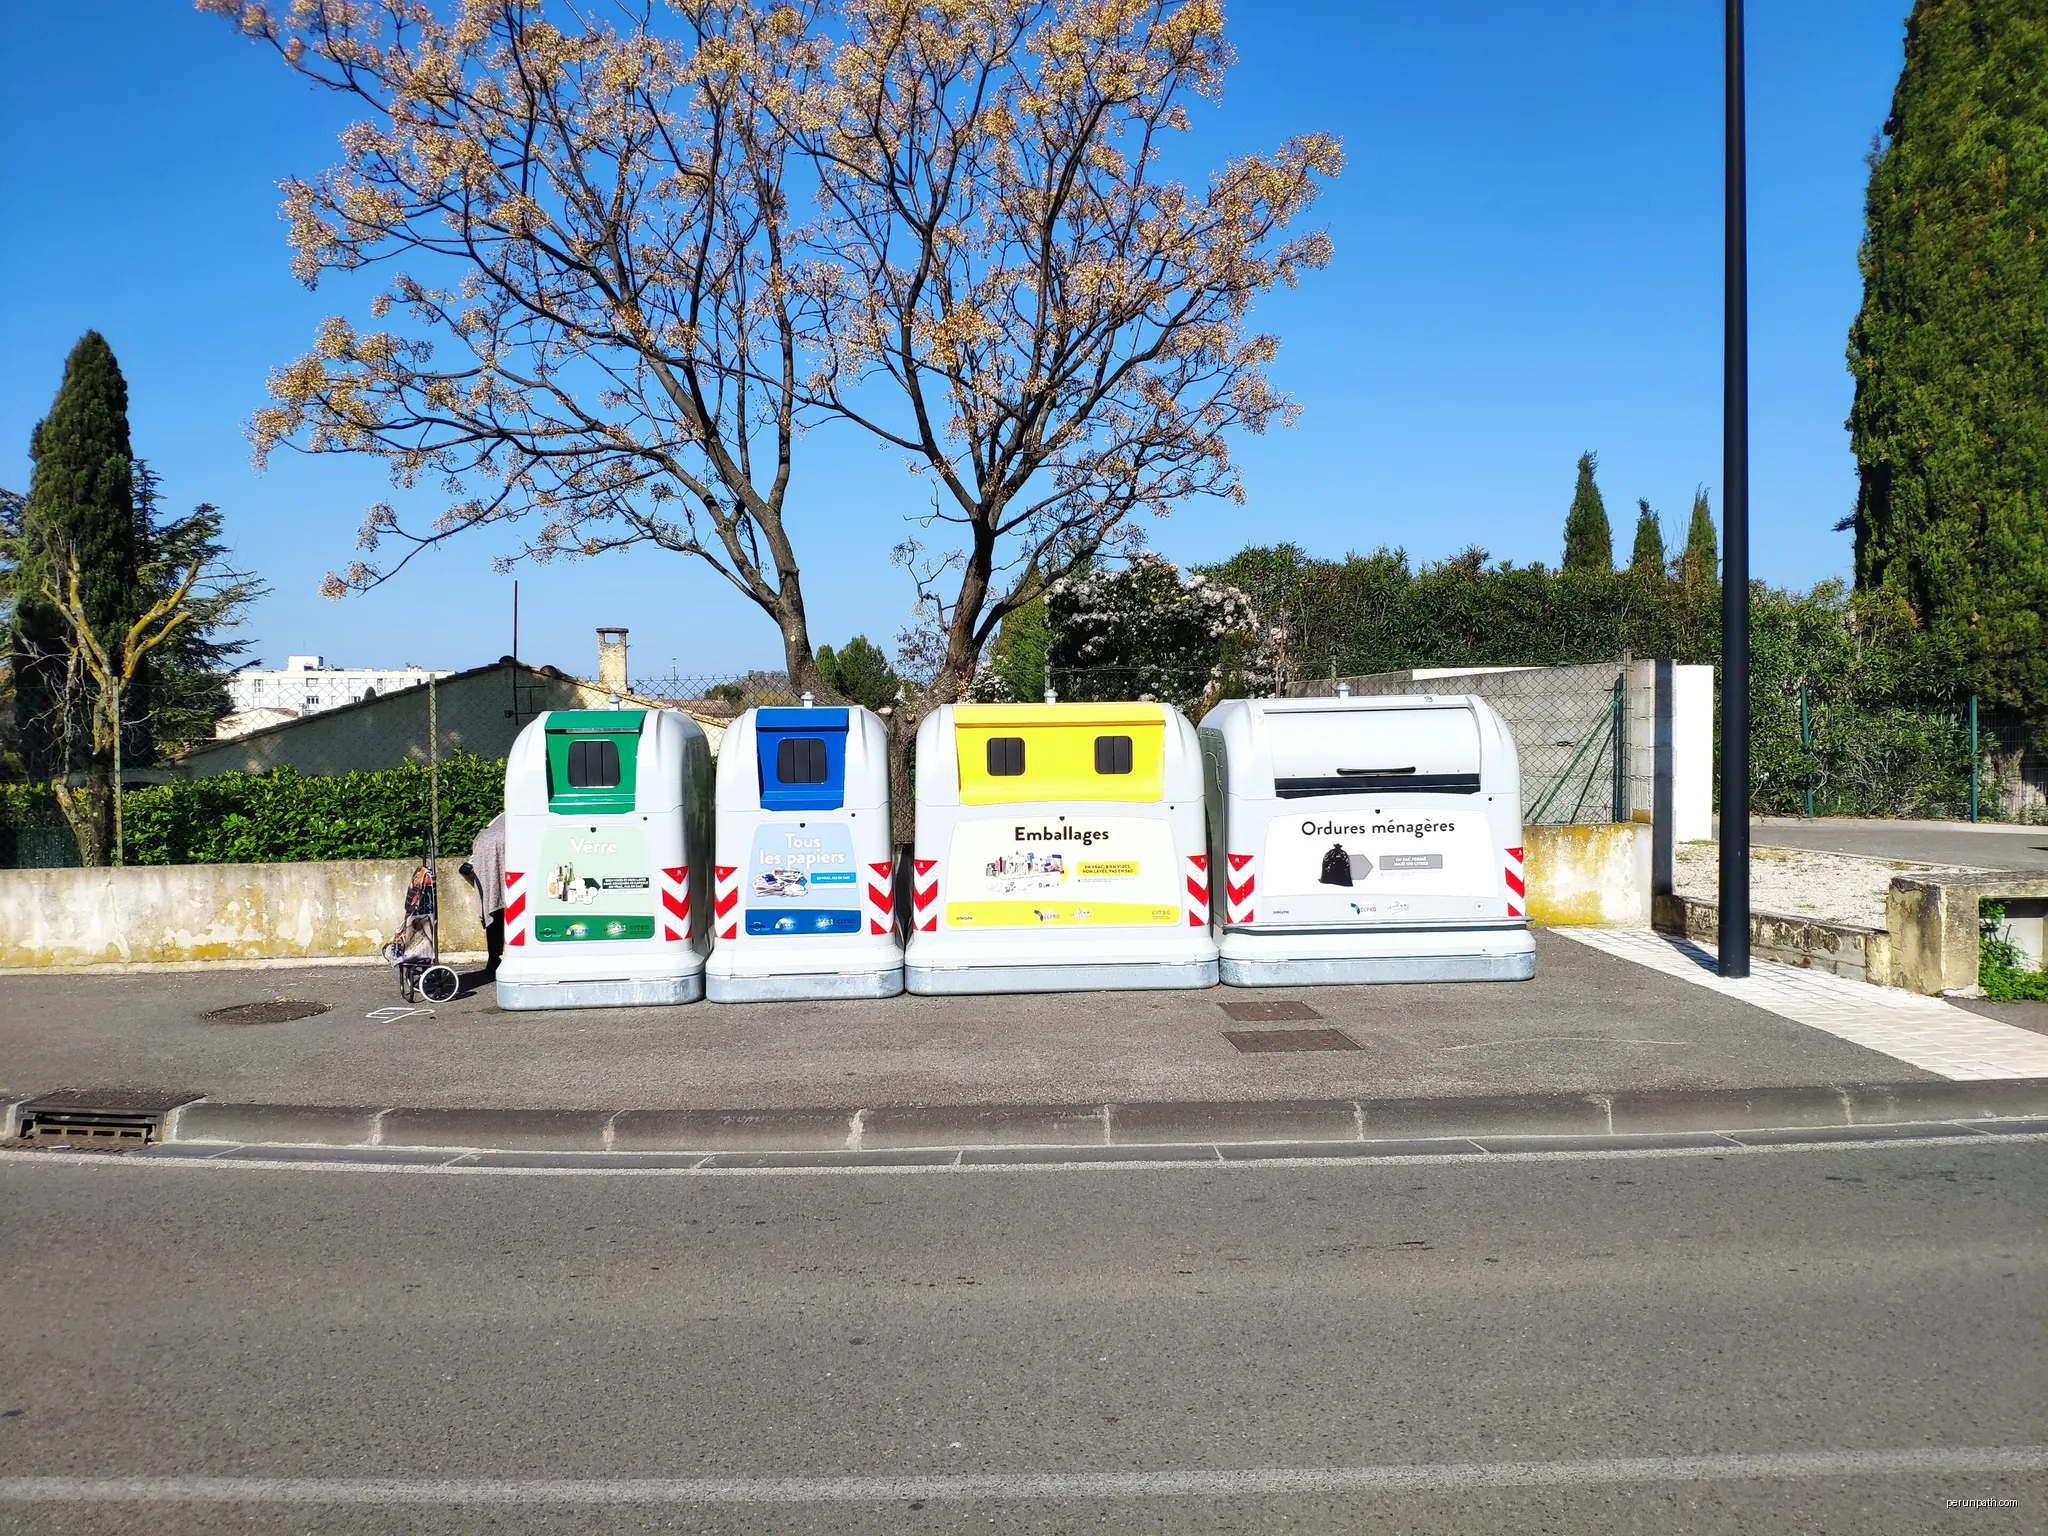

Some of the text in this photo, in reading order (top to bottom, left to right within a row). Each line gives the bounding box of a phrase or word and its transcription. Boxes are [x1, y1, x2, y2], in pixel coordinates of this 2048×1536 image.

[1015, 826, 1109, 846] Emballages
[1301, 819, 1455, 838] Ordures ménagères
[570, 838, 618, 853] Verre
[784, 834, 821, 849] Tous
[759, 849, 846, 869] les papiers
